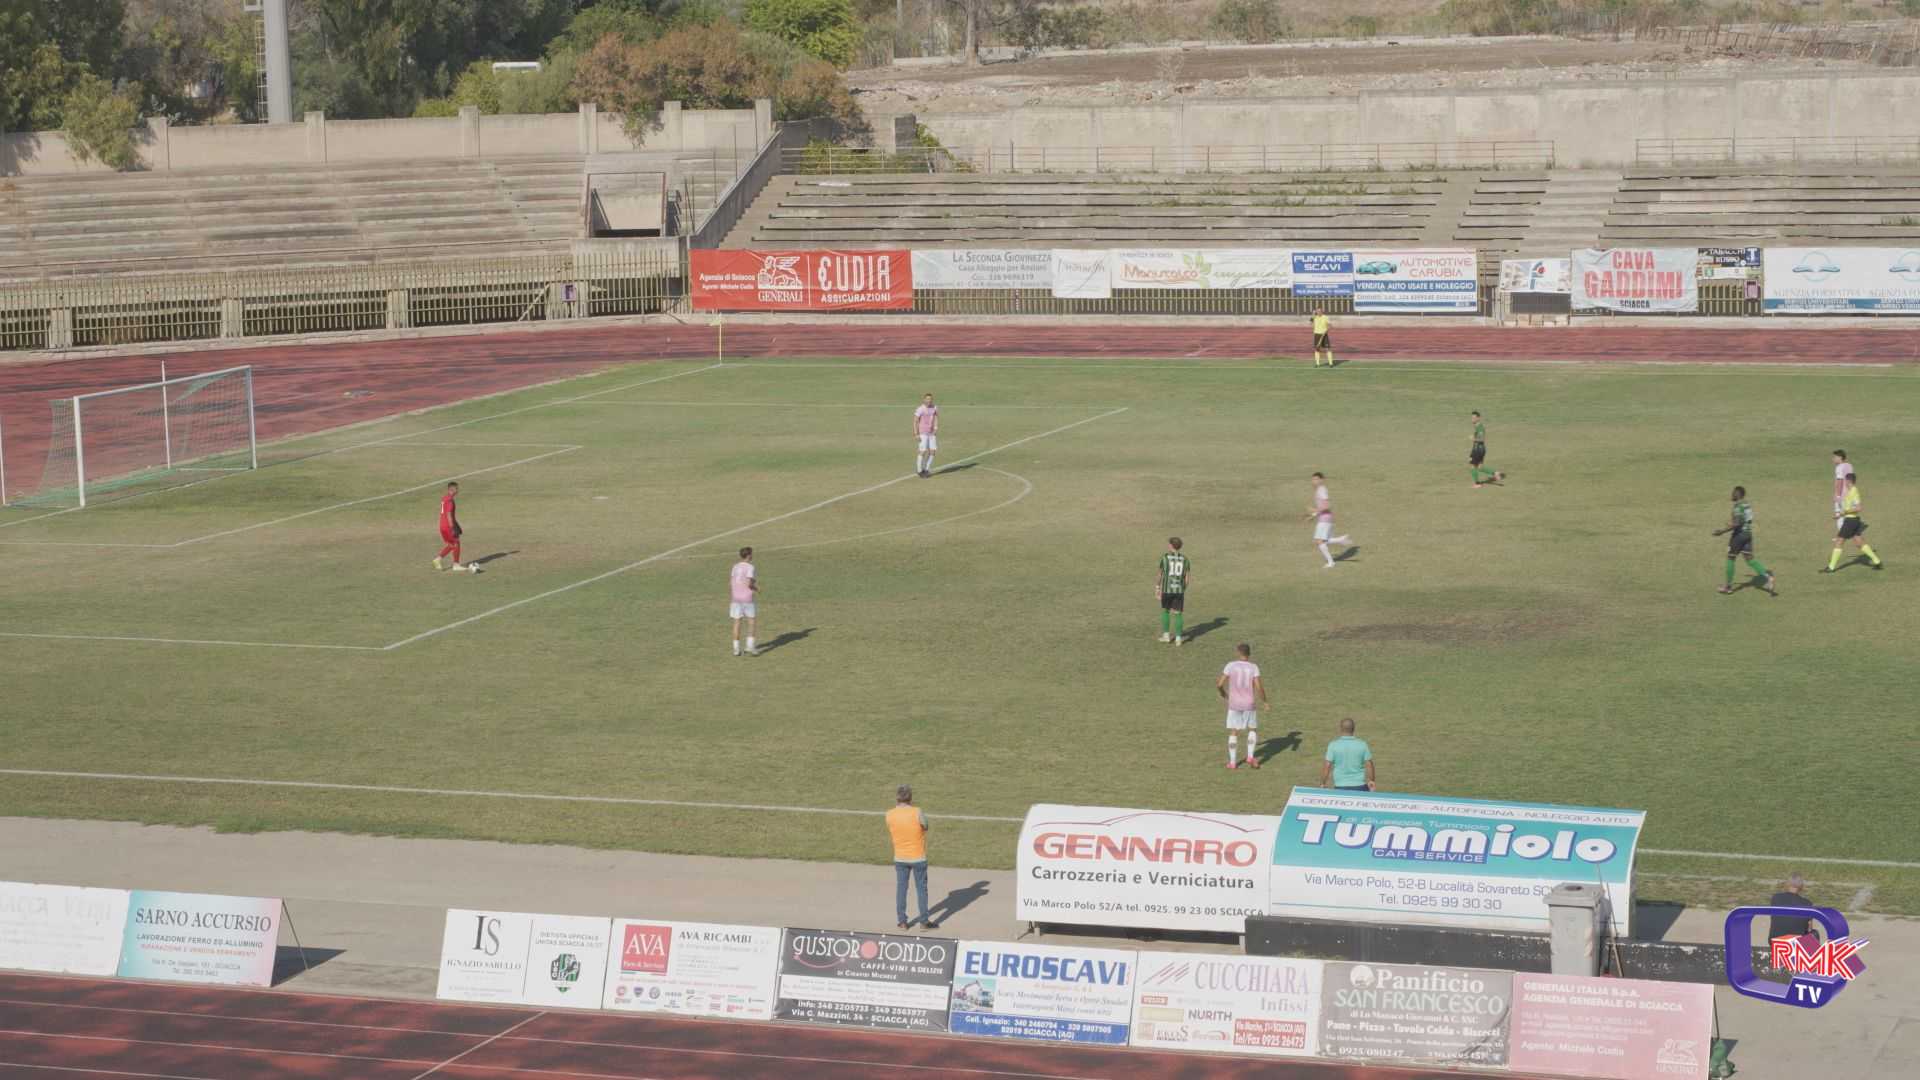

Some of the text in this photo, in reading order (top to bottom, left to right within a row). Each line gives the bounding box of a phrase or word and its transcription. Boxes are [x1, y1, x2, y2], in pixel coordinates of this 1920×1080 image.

[1303, 263, 1341, 271] SCAVI
[1399, 257, 1473, 267] AUTOMOTIVE
[1612, 251, 1655, 270] CAVA
[1409, 268, 1464, 277] CARUBIA
[1356, 281, 1386, 289] VENDITA
[1436, 282, 1474, 290] NOLEGGIO
[1584, 271, 1684, 299] GADDIMI
[758, 290, 803, 302] GENERALI
[820, 292, 891, 303] ASSICURAZIONI
[1619, 299, 1651, 308] SCIACCA
[1169, 562, 1183, 576] 10
[1301, 797, 1354, 807] CENTRO
[1356, 800, 1420, 810] REVISIONE
[1524, 811, 1590, 822] NOLEGGIO
[1592, 816, 1631, 824] AUTO
[1296, 812, 1616, 864] Tummiolo
[1033, 831, 1257, 868] GENNARO
[1374, 849, 1485, 863] CAR SERVICE
[1031, 865, 1254, 889] Carrozzeria e Verniciatura
[1305, 873, 1322, 884] Via
[1325, 874, 1363, 887] Marco
[1366, 876, 1394, 889] Polo,
[1397, 878, 1426, 890] 52-B
[1477, 883, 1530, 895] Sovareto
[1023, 898, 1038, 908] Via
[1041, 899, 1071, 909] Marco
[1074, 900, 1096, 910] Polo
[1099, 901, 1123, 912] 52/A
[1126, 902, 1142, 912] tel.
[1174, 904, 1186, 914] 99
[1190, 905, 1201, 915] 23
[1205, 906, 1217, 916] 00
[1378, 894, 1502, 910] Tel. 0925 99 30 30
[135, 907, 189, 926] SARNO
[191, 911, 272, 932] ACCURSIO
[136, 934, 186, 944] LAVORAZIONE
[187, 936, 211, 945] FERRO
[224, 938, 263, 948] ALLUMINIO
[472, 915, 501, 956] IS
[678, 930, 699, 940] AVA
[703, 932, 752, 944] RICAMBI
[625, 933, 666, 957] AVA
[964, 951, 1127, 986] EUROSCAVI
[1194, 960, 1309, 995] CUCCHIARA
[1376, 968, 1484, 994] Panificio
[1523, 981, 1576, 994] GENERALI
[1577, 985, 1609, 996] ITALIA
[1261, 997, 1308, 1013] Infissi
[1334, 989, 1504, 1015] SAN FRANCESCO
[1569, 996, 1624, 1008] GENERALE
[1625, 999, 1637, 1009] DI
[1638, 1001, 1683, 1012] SCIACCA
[791, 1009, 805, 1017] Via
[871, 1014, 908, 1025] SCIACCA
[982, 1017, 1010, 1026] Ignazio:
[1188, 1008, 1233, 1022] NURITH
[1023, 1027, 1056, 1039] SCIACCA
[1359, 1022, 1385, 1032] Pizza
[1393, 1023, 1425, 1034] Tavola
[1426, 1025, 1454, 1035] Calda
